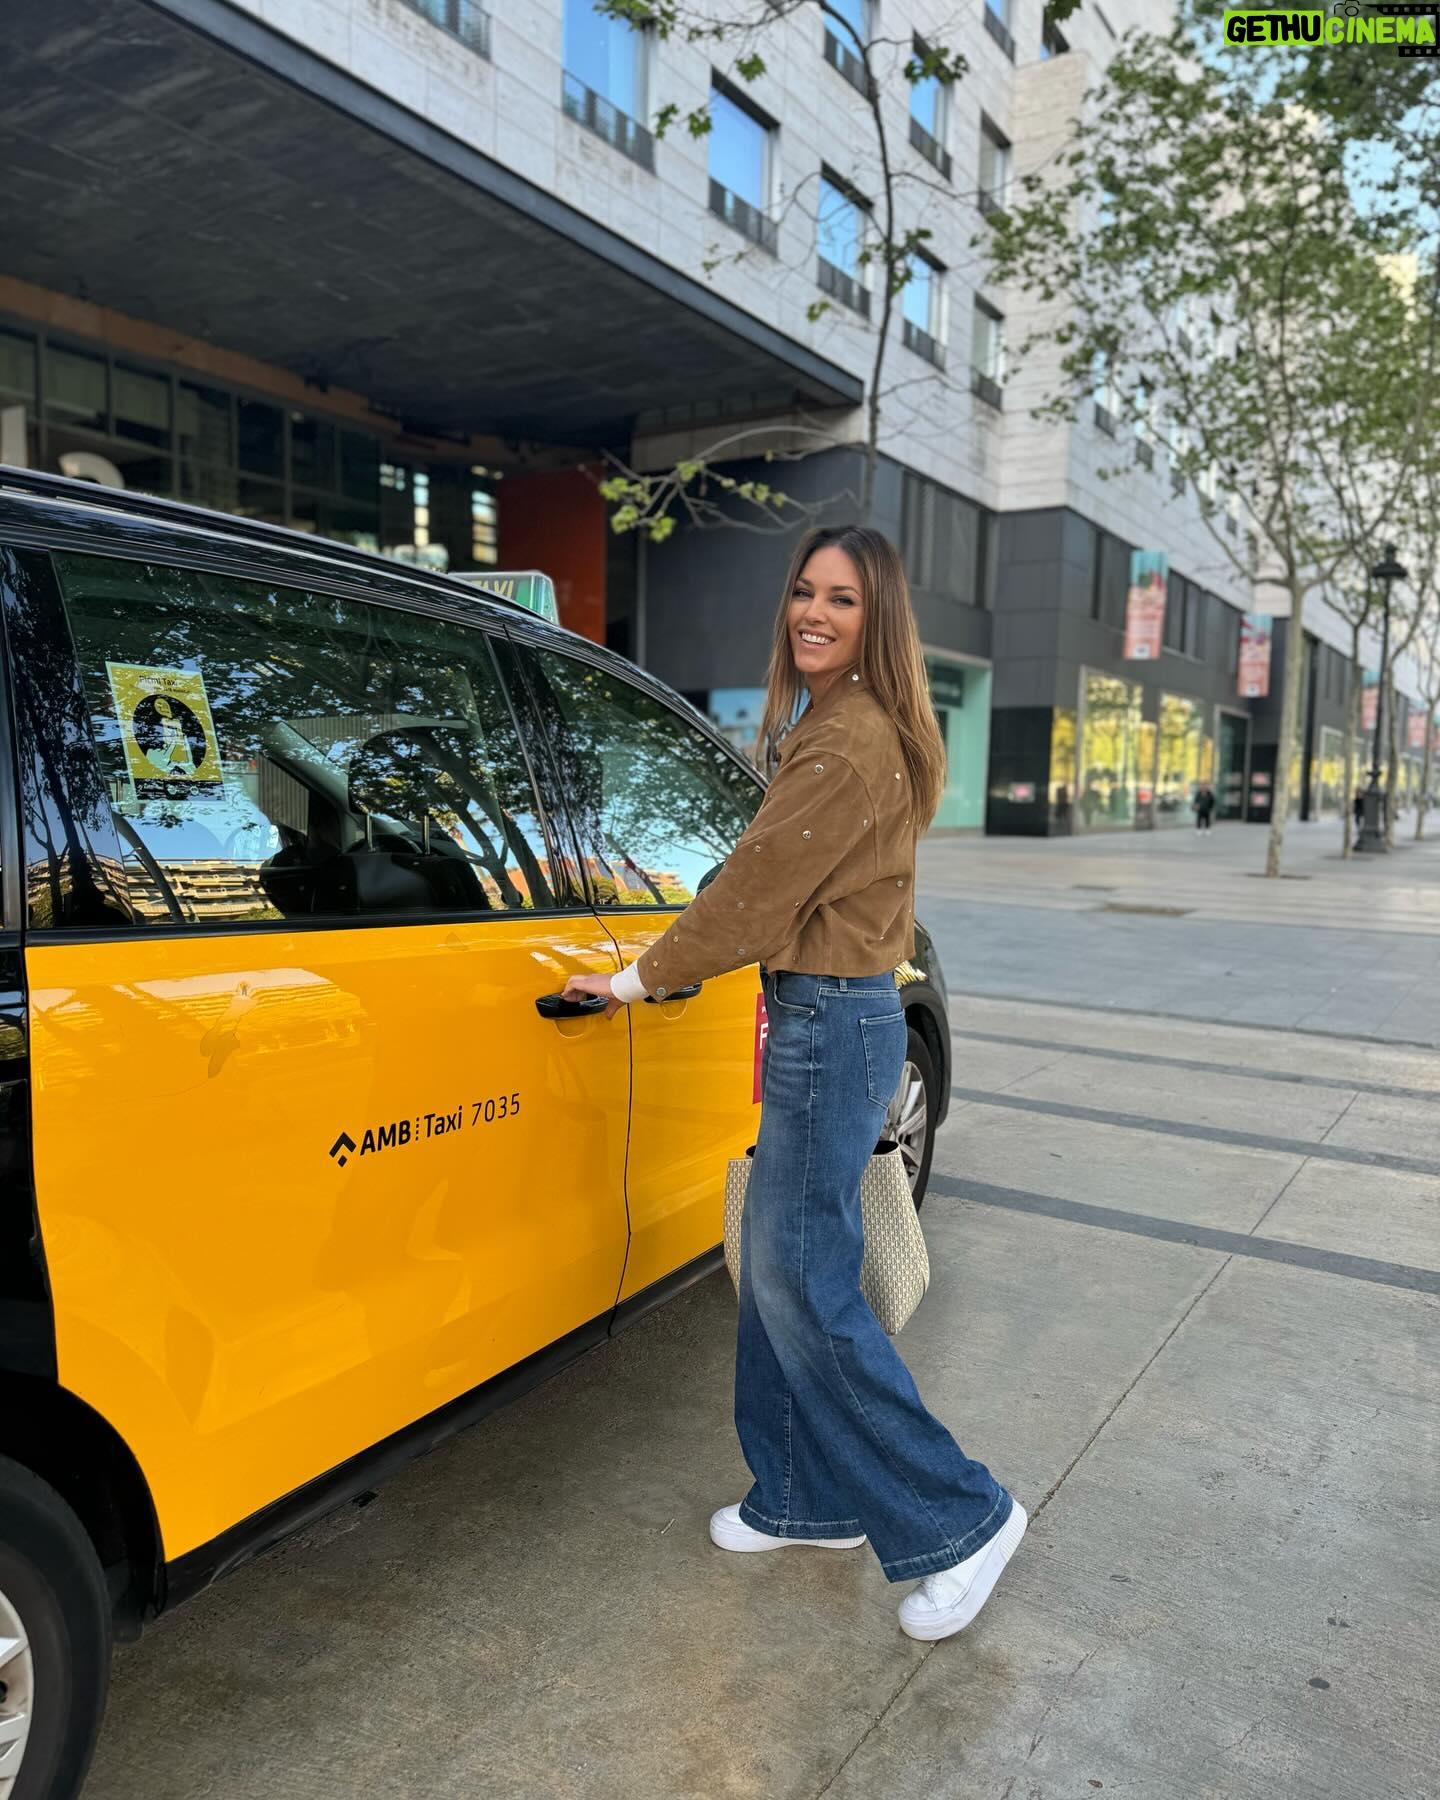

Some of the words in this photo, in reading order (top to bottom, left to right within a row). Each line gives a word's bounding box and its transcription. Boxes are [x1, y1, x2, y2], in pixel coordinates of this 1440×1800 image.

[359, 1119, 411, 1156] AMB
[423, 1105, 463, 1138] Taxi
[471, 1092, 520, 1127] 7035
